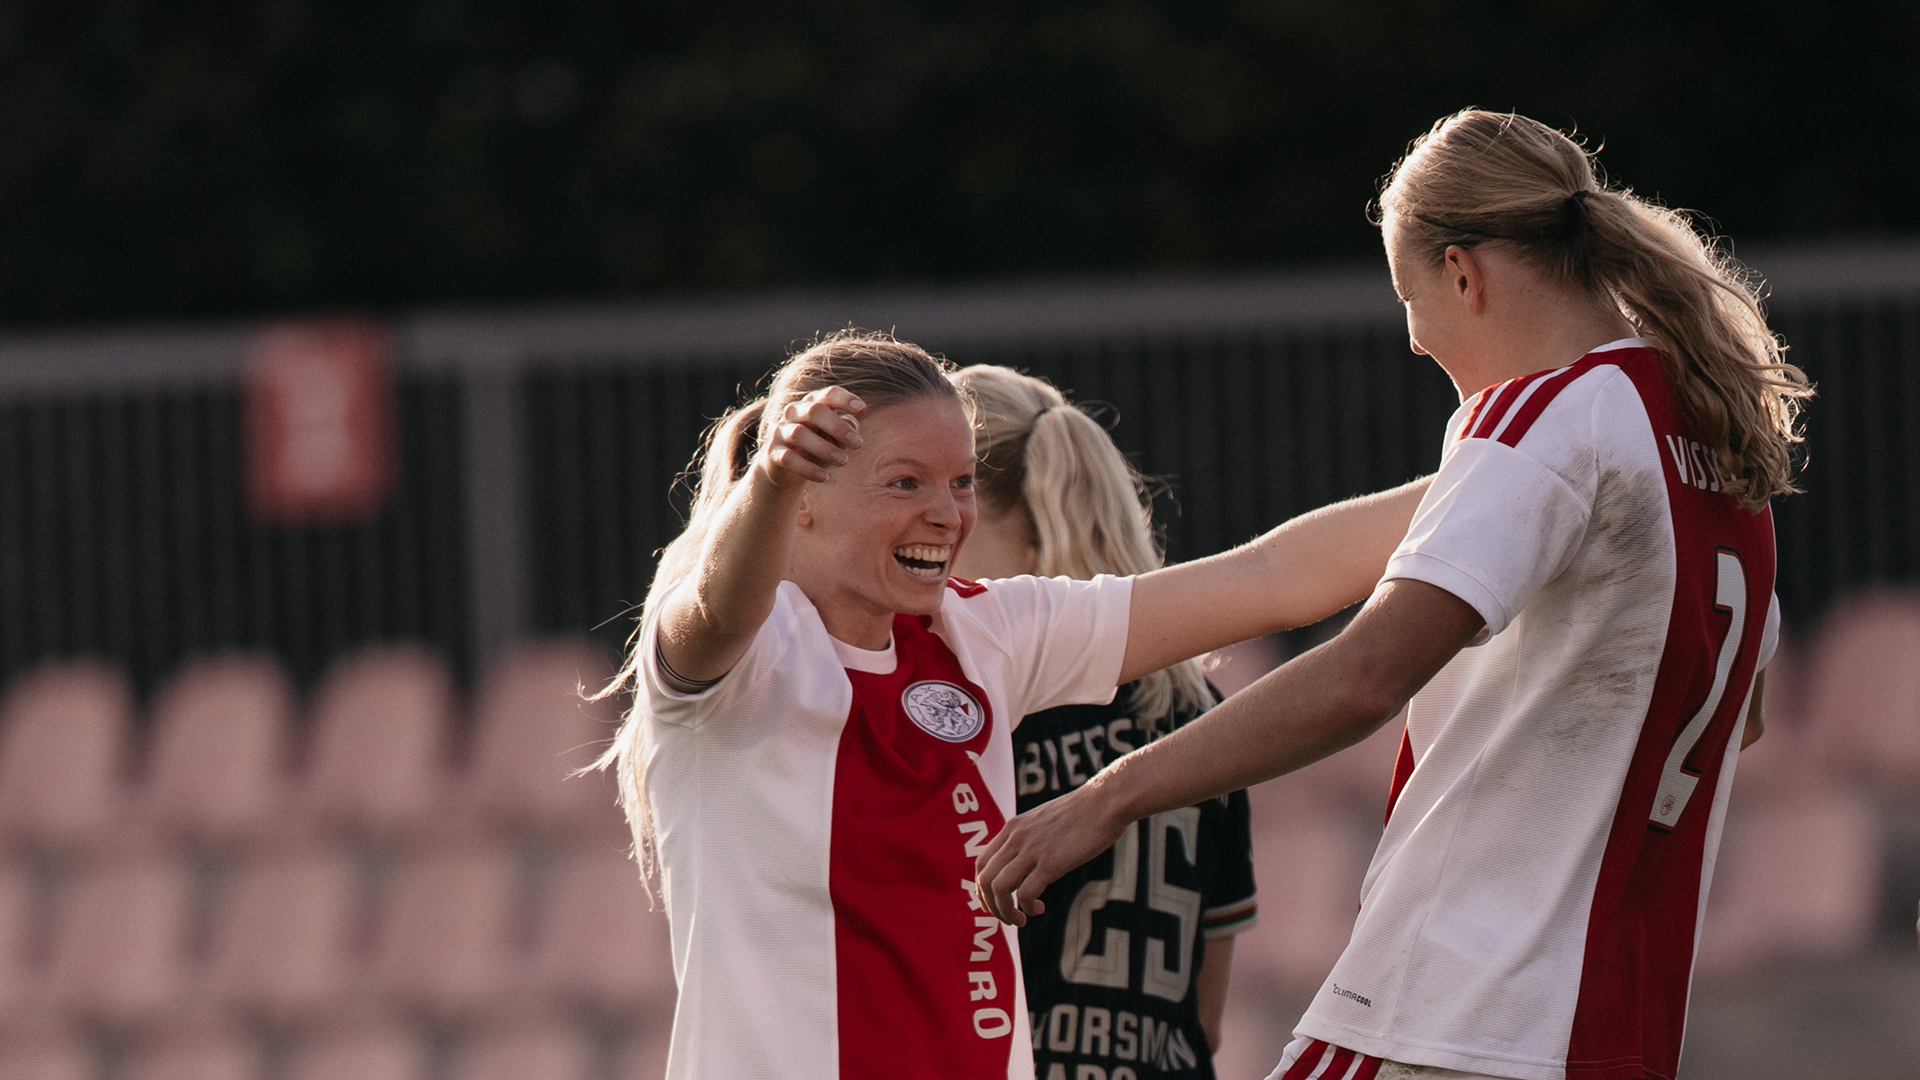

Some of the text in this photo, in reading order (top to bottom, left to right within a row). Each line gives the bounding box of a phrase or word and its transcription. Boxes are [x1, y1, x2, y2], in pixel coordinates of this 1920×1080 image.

[1665, 434, 1737, 492] VISS
[1648, 549, 1748, 828] 2
[952, 750, 1012, 1040] BN AMRO
[1060, 807, 1201, 1004] 25
